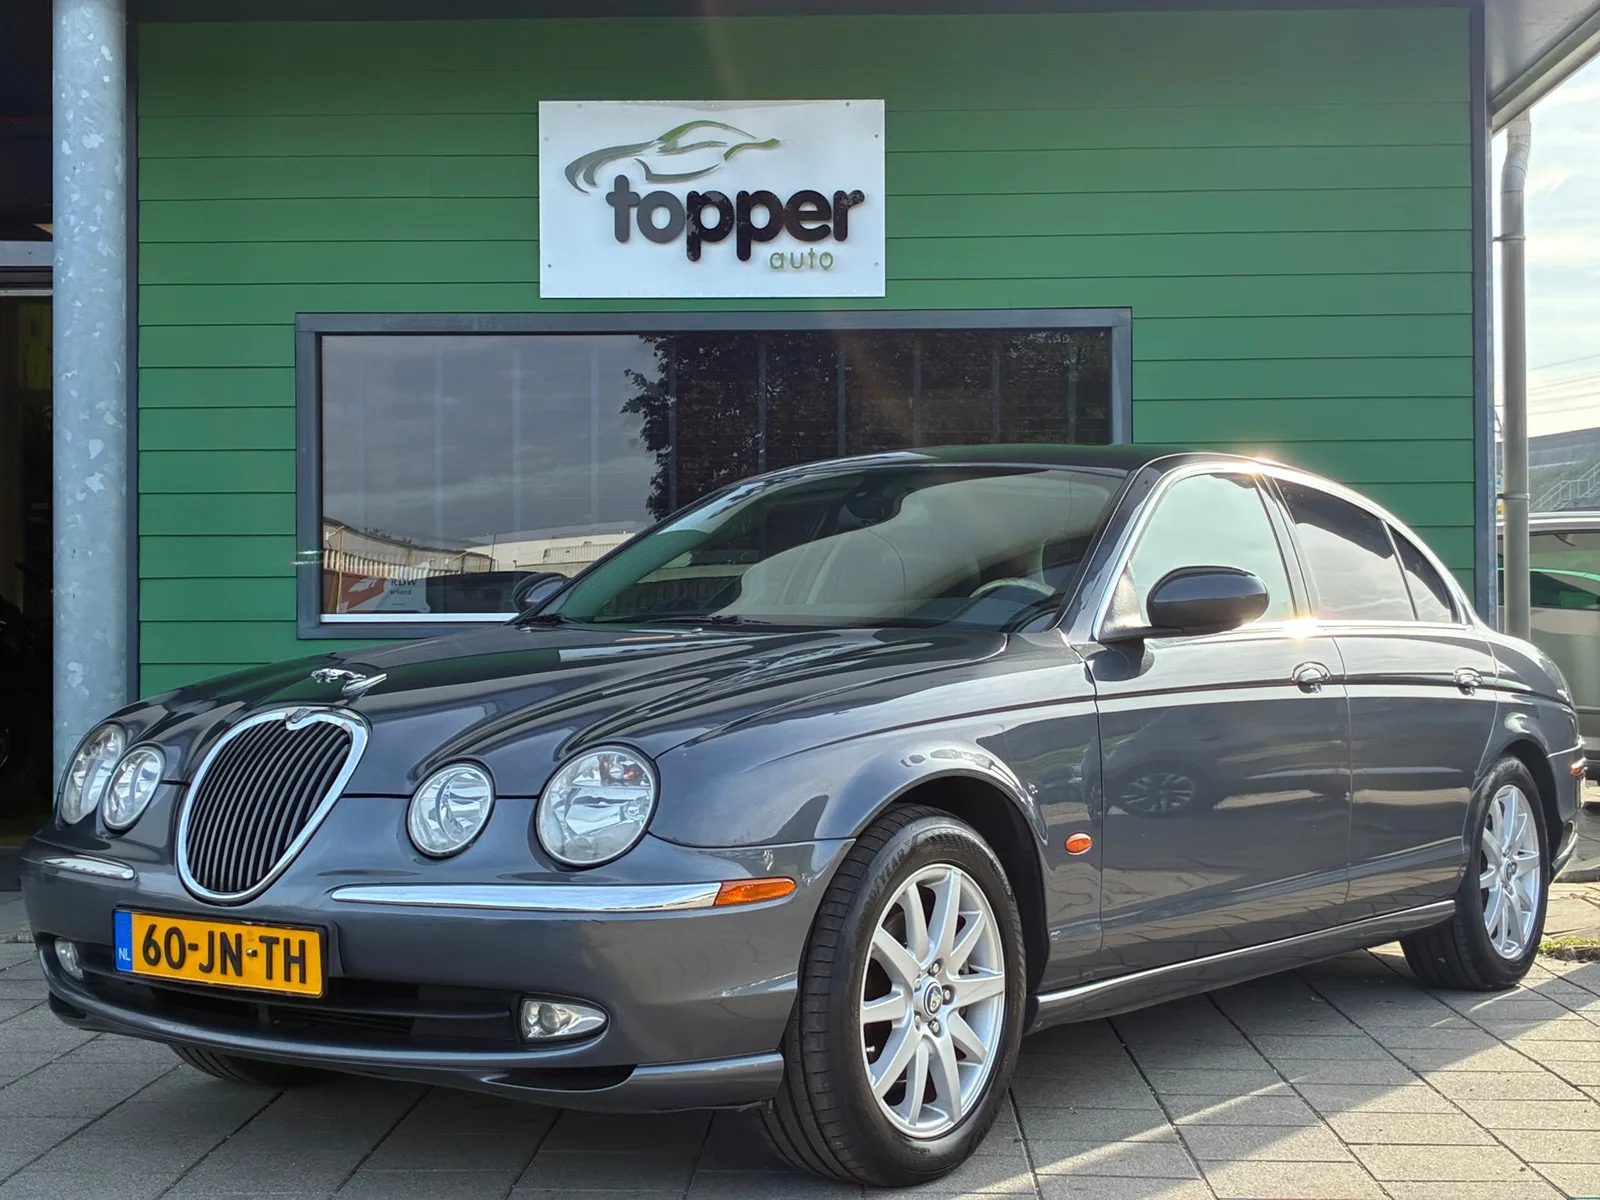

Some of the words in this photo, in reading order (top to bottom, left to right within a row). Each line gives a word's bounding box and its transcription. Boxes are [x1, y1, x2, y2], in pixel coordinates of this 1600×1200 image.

[605, 174, 865, 262] topper
[769, 248, 834, 270] auto
[390, 577, 417, 587] RDW
[858, 848, 906, 932] ODYEAR
[118, 947, 131, 961] NL
[142, 924, 307, 984] 60-JN-TH
